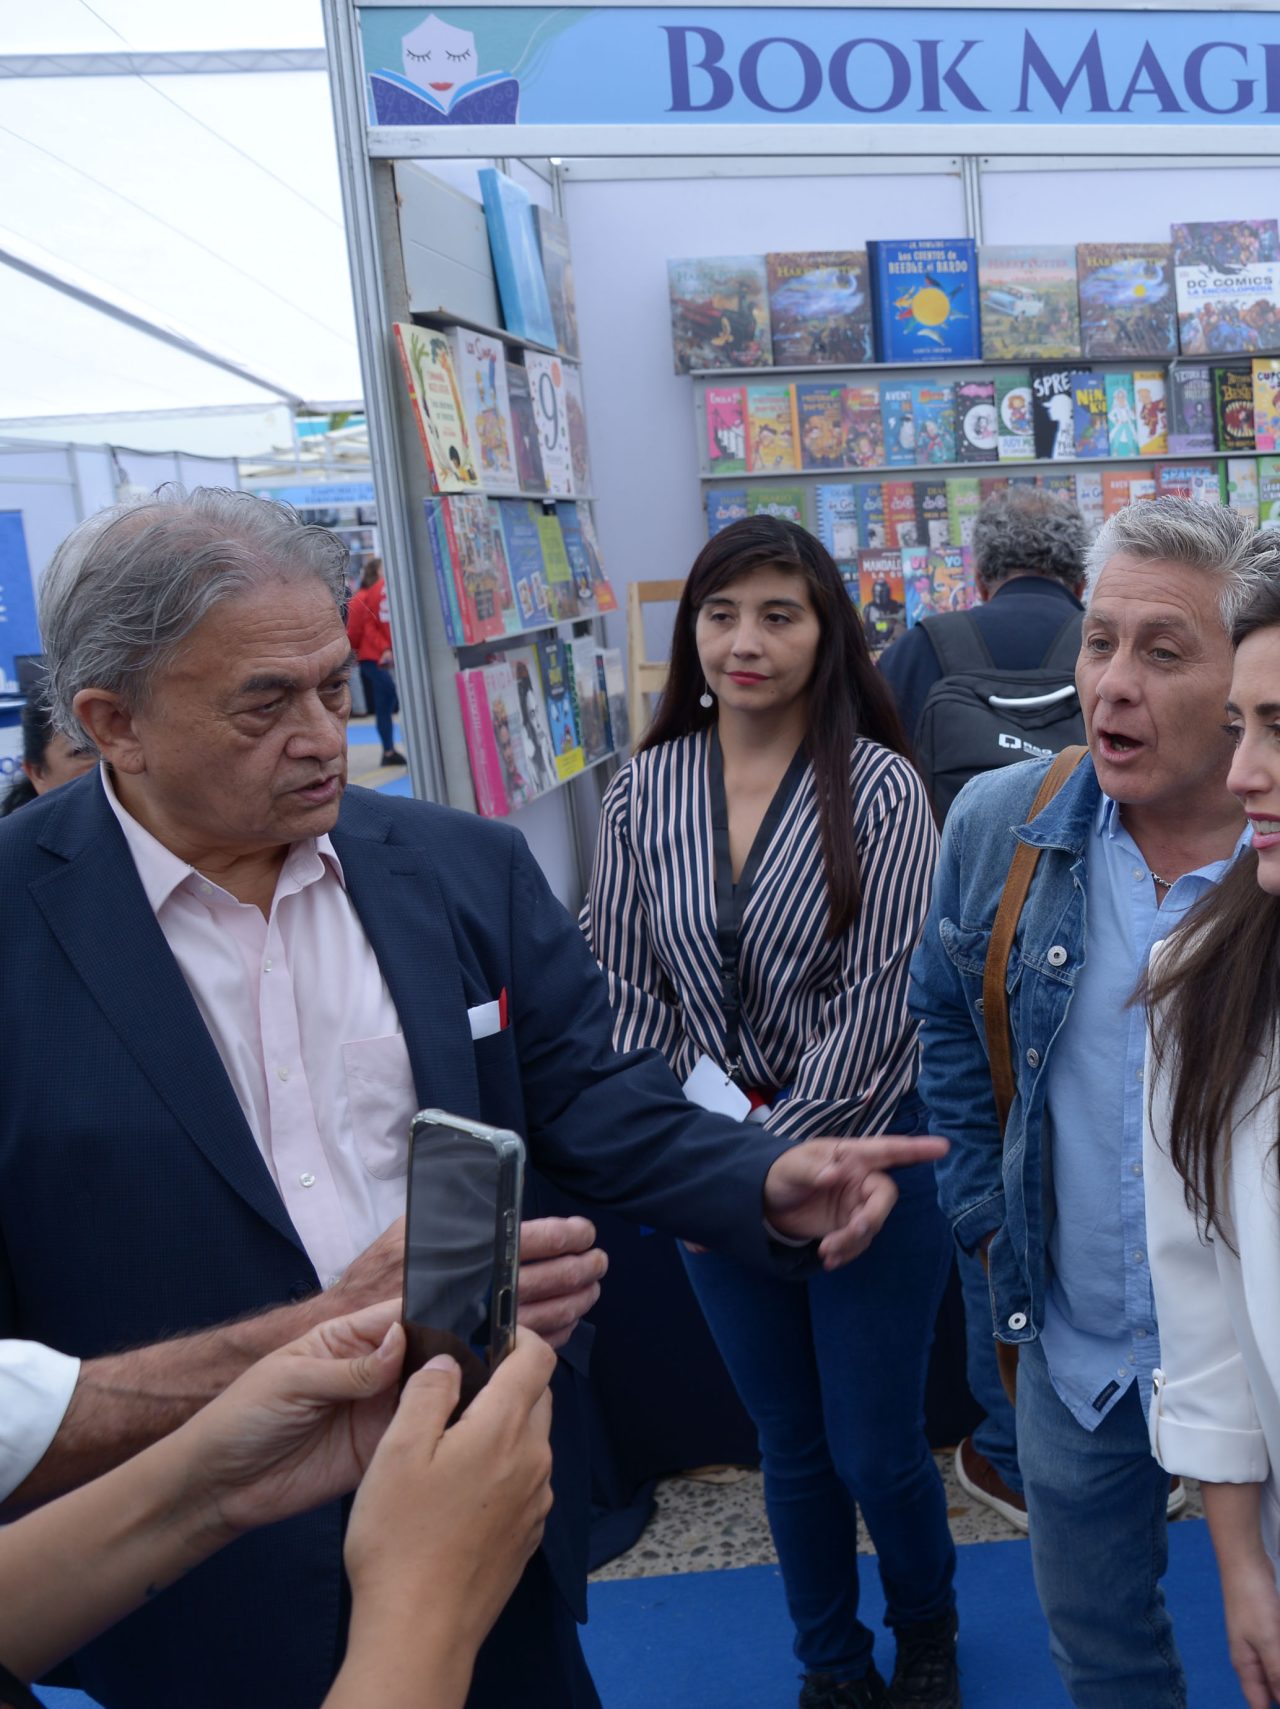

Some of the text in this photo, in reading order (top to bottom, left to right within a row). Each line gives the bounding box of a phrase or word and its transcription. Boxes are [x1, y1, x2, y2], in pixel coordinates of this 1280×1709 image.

[659, 25, 992, 115] BOOK
[1186, 276, 1273, 289] DC COMICS
